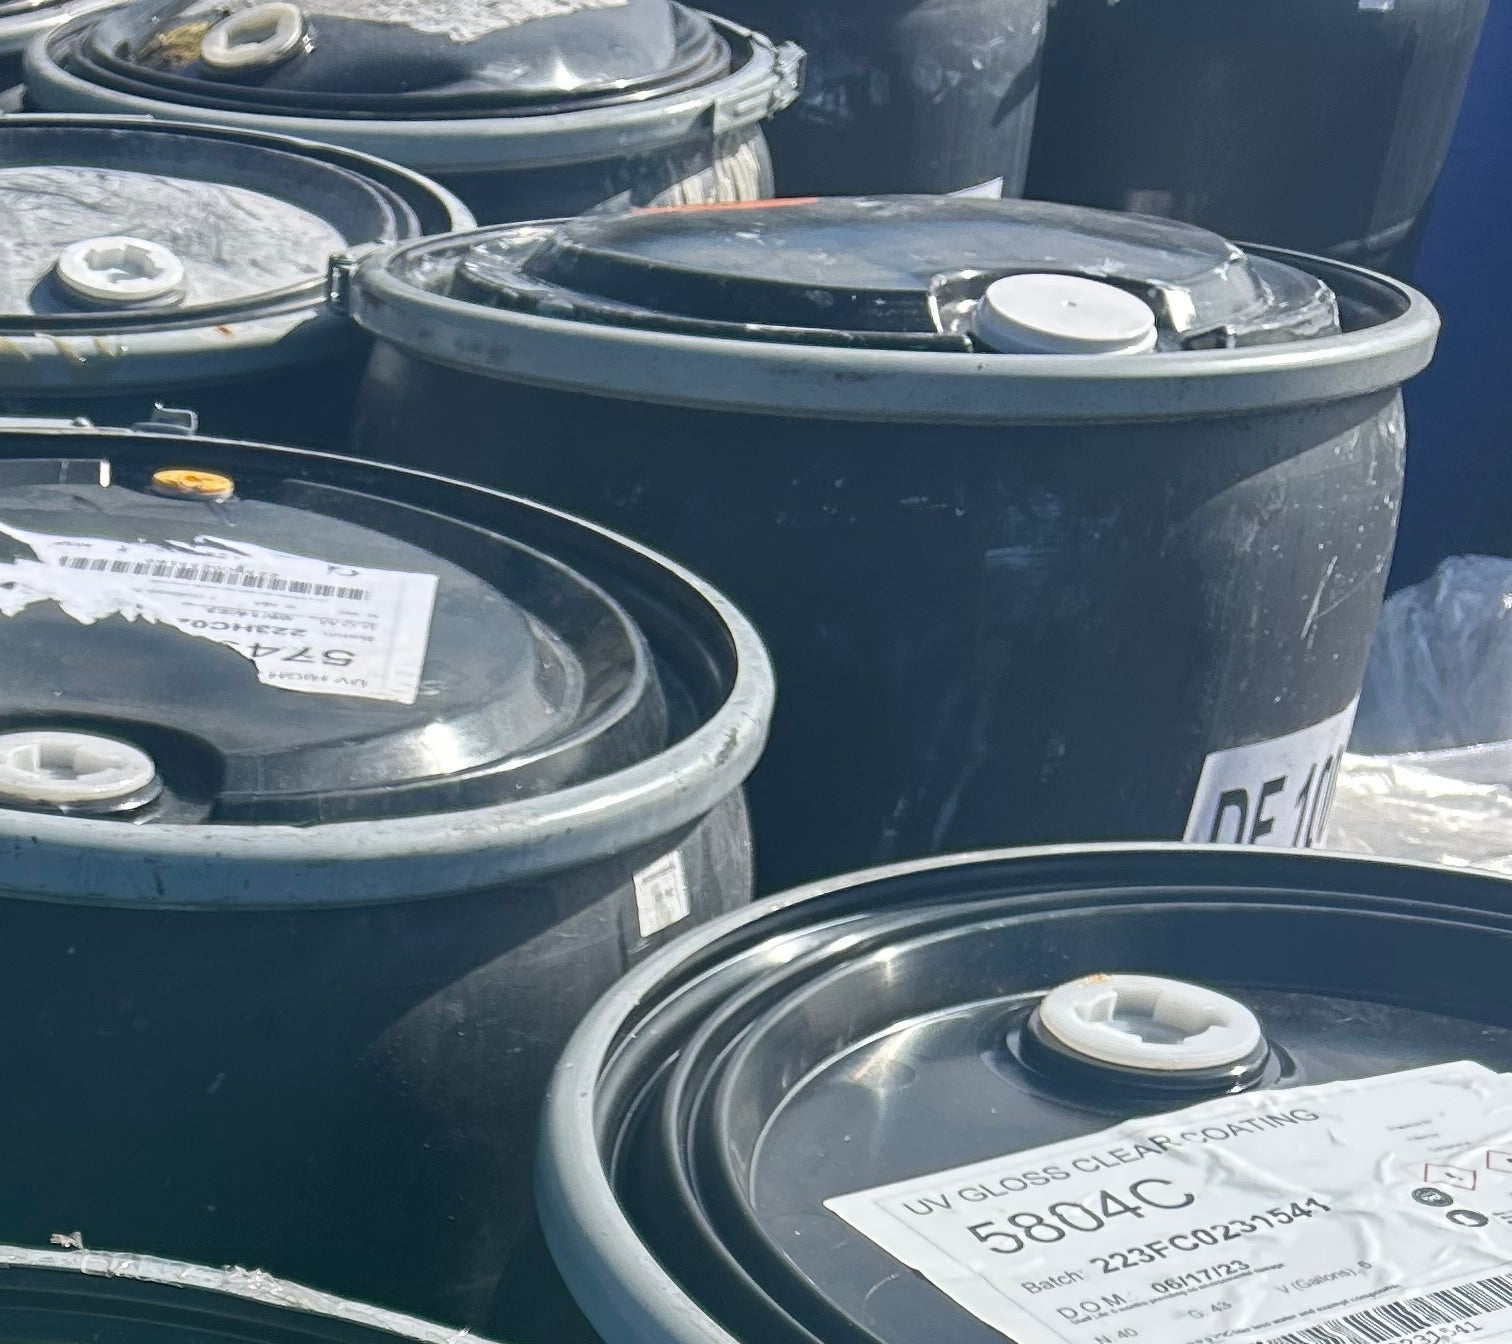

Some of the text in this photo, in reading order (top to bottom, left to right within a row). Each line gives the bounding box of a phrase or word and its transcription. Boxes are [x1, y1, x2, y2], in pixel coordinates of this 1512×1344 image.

[221, 639, 357, 668] 574
[903, 1108, 1320, 1217] UV GLOSS CLEAR COATING
[966, 1177, 1196, 1255] 5804C
[1089, 1197, 1331, 1274] 223FC0231541
[1150, 1258, 1251, 1294] 06/17/23
